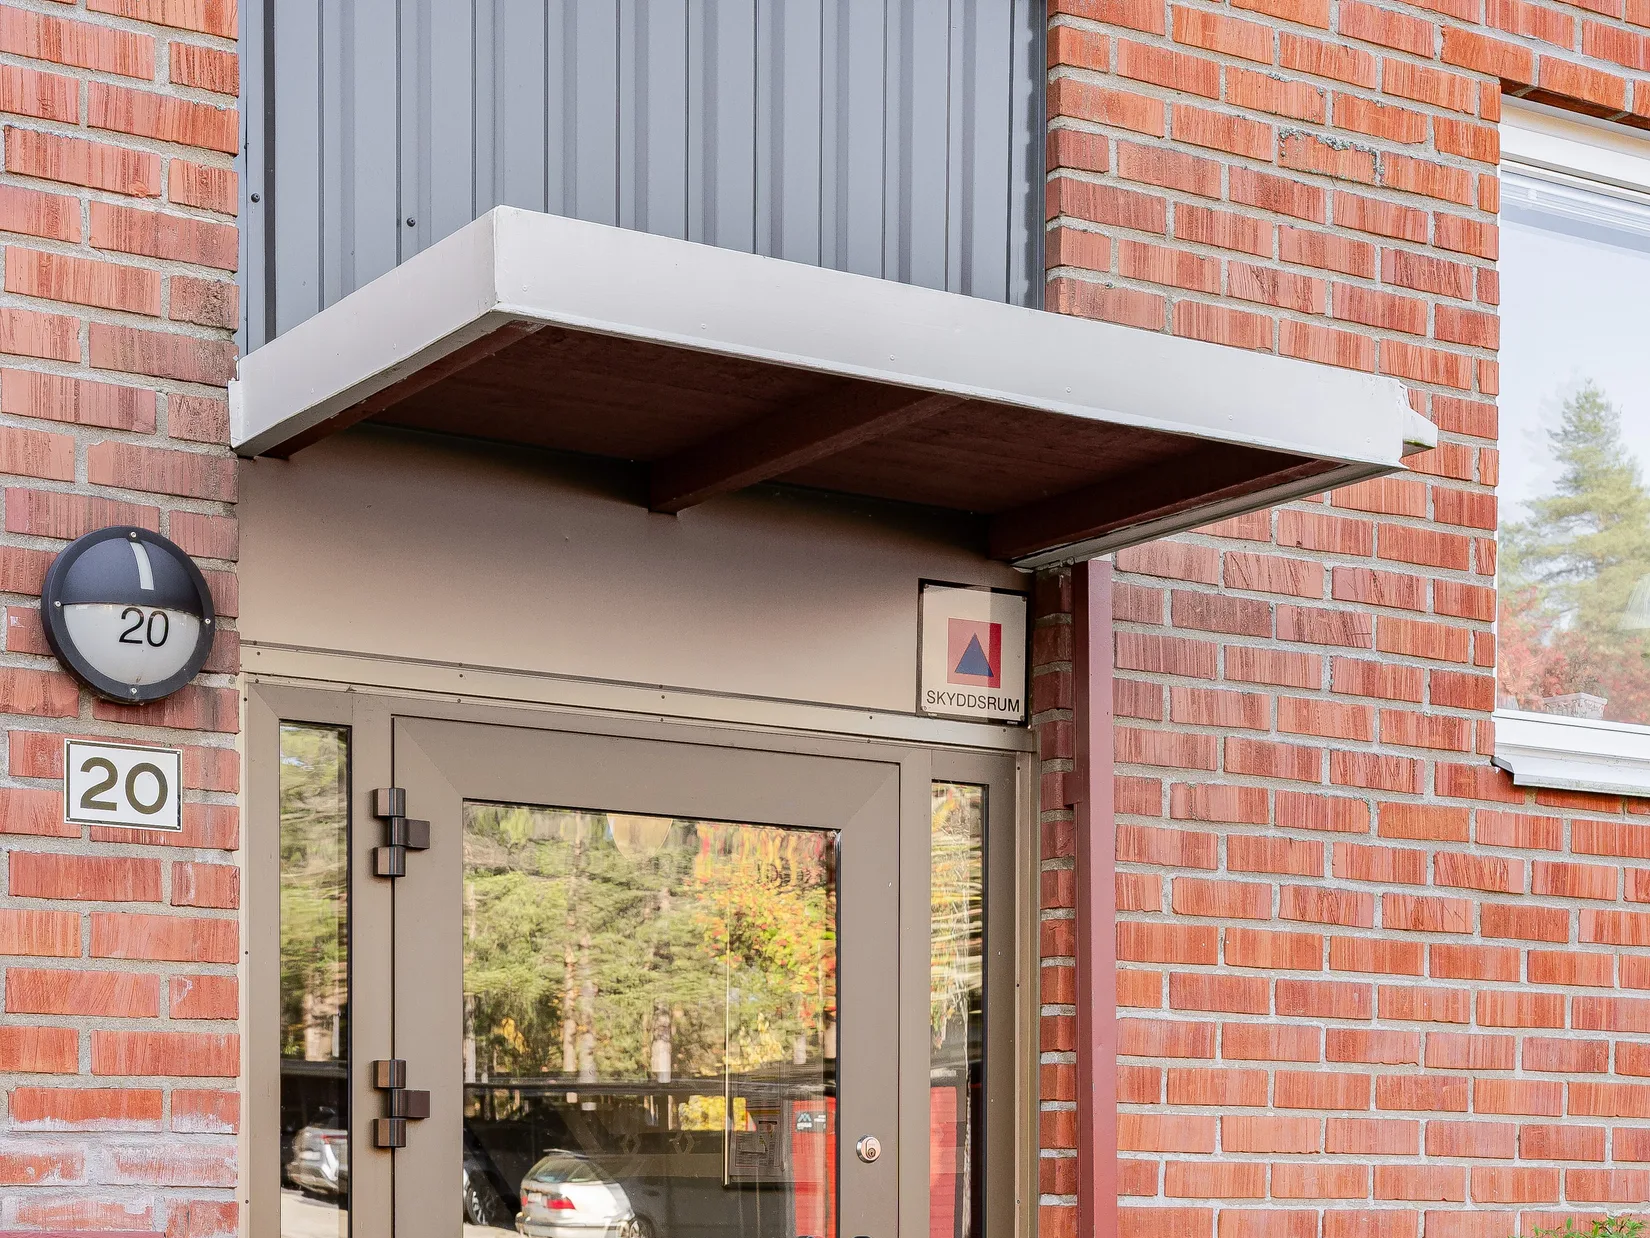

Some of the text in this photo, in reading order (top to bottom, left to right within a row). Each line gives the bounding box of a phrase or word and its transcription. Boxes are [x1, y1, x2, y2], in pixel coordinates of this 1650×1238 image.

[119, 607, 169, 647] 20
[926, 690, 1020, 713] SKYDDSRUM
[80, 757, 168, 815] 20
